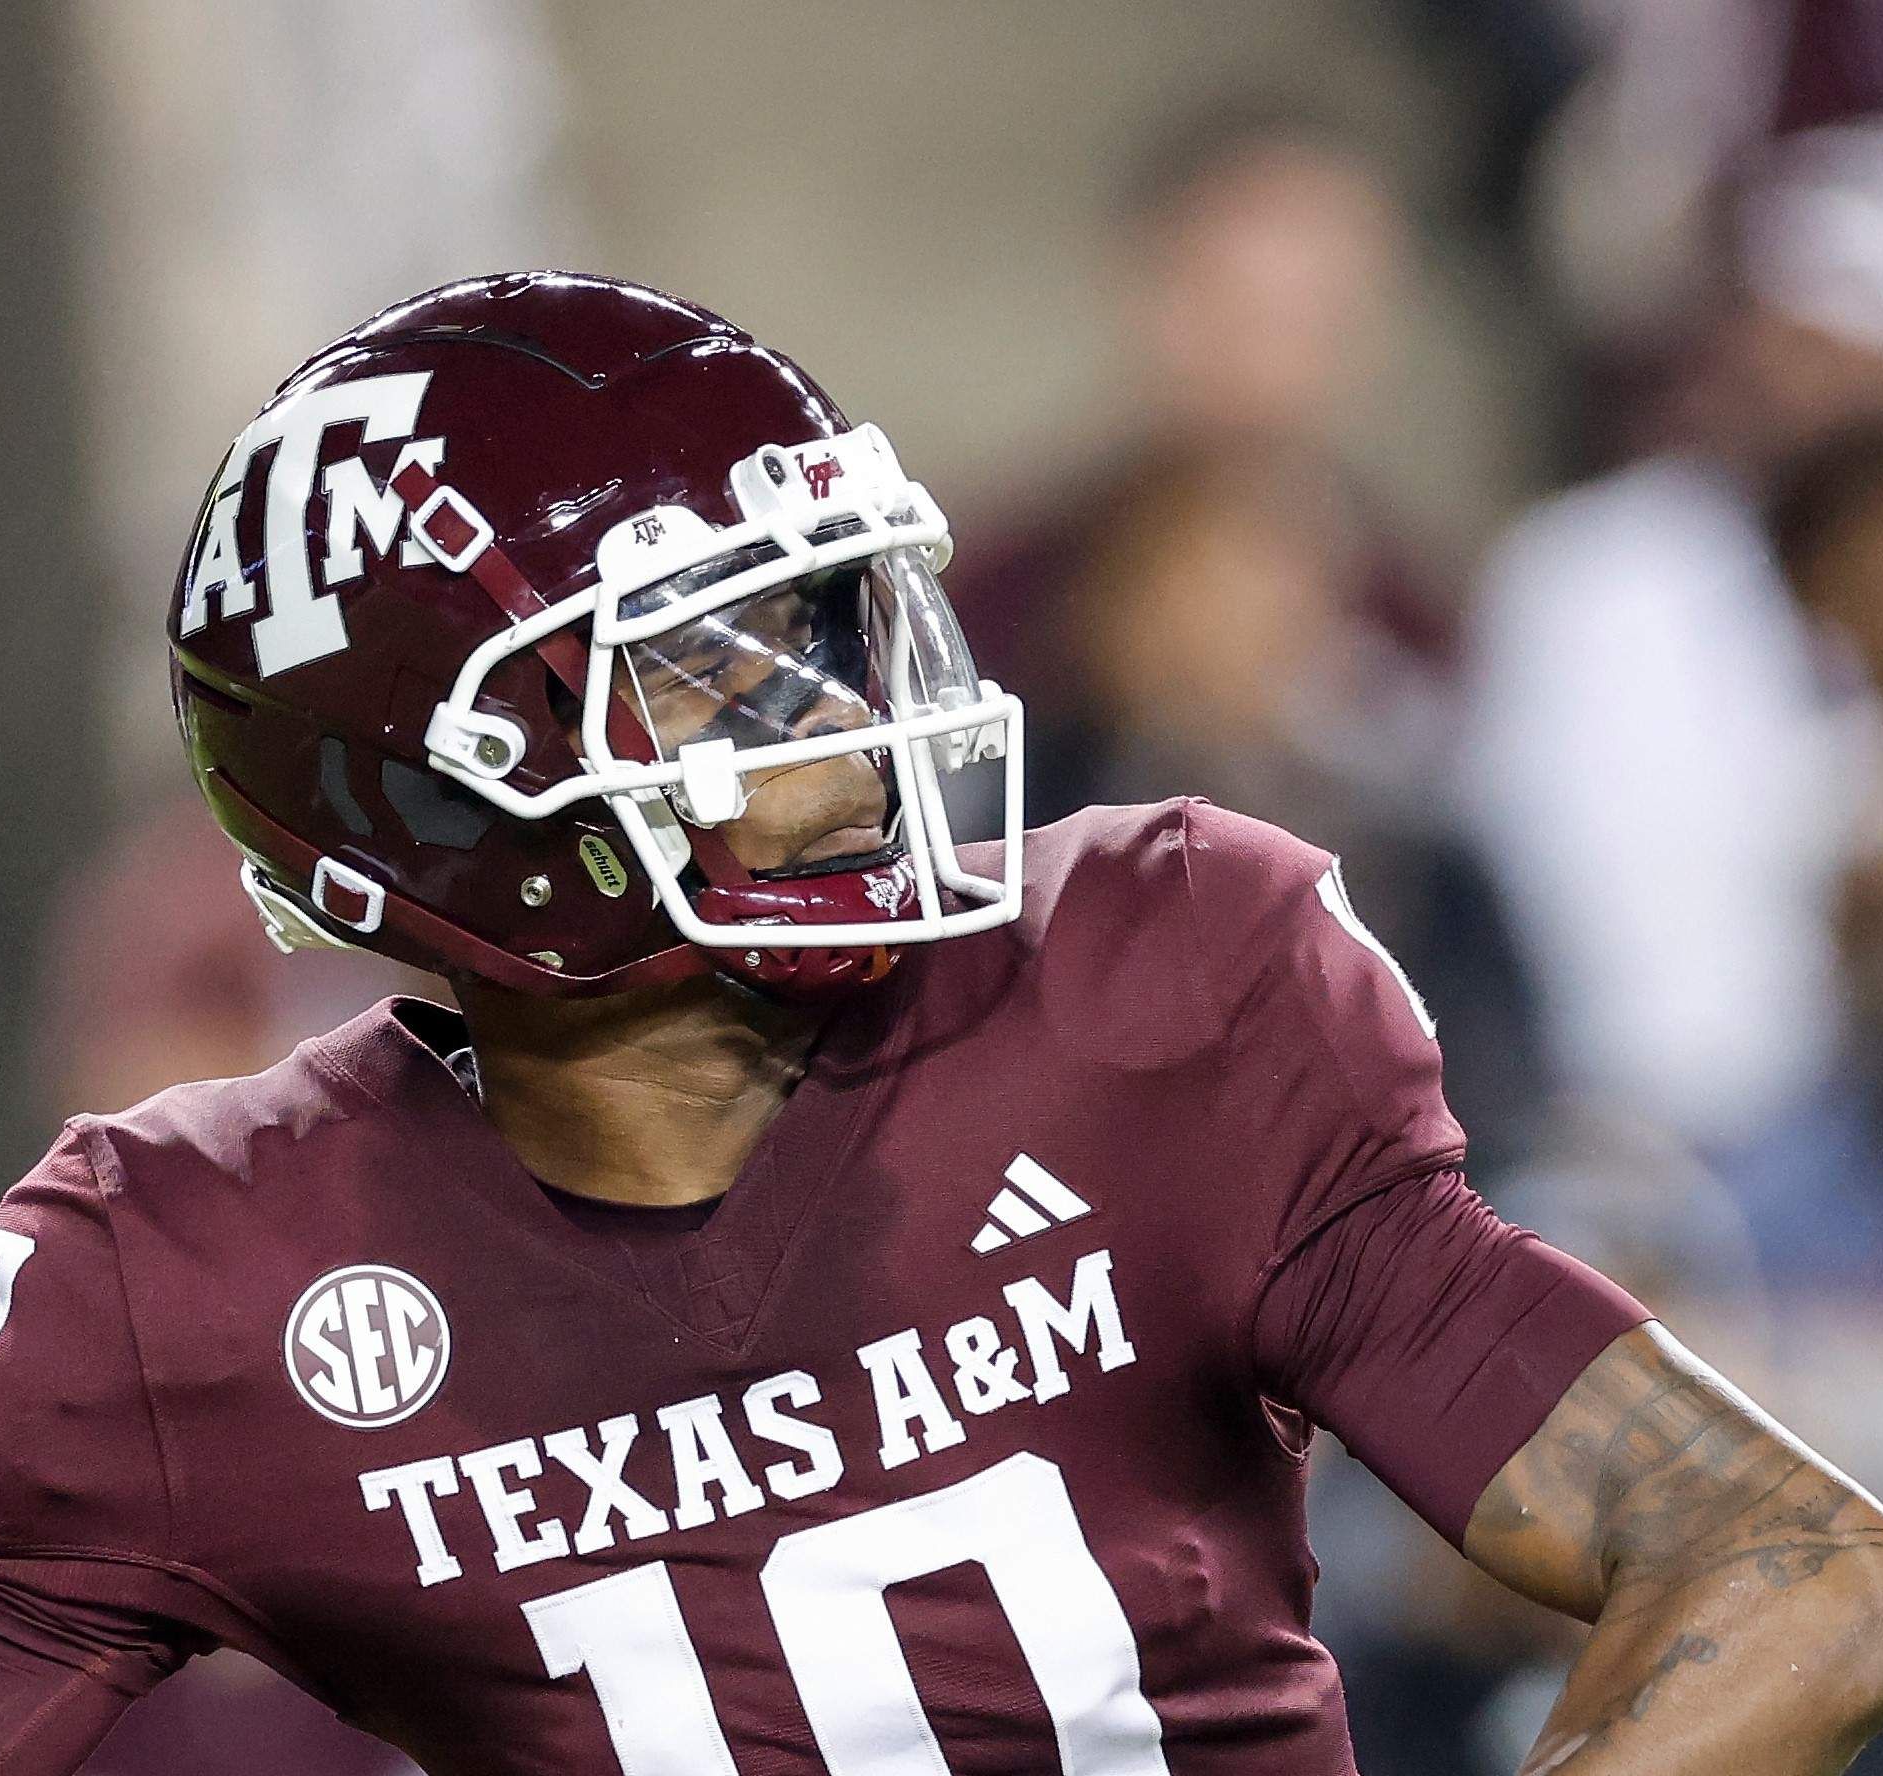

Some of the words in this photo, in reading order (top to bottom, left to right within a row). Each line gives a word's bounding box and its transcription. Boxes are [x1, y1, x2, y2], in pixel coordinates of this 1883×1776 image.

[582, 838, 622, 889] schutt
[298, 1278, 435, 1414] SEC
[357, 1367, 846, 1588] TEXAS
[856, 1248, 1138, 1470] A&M
